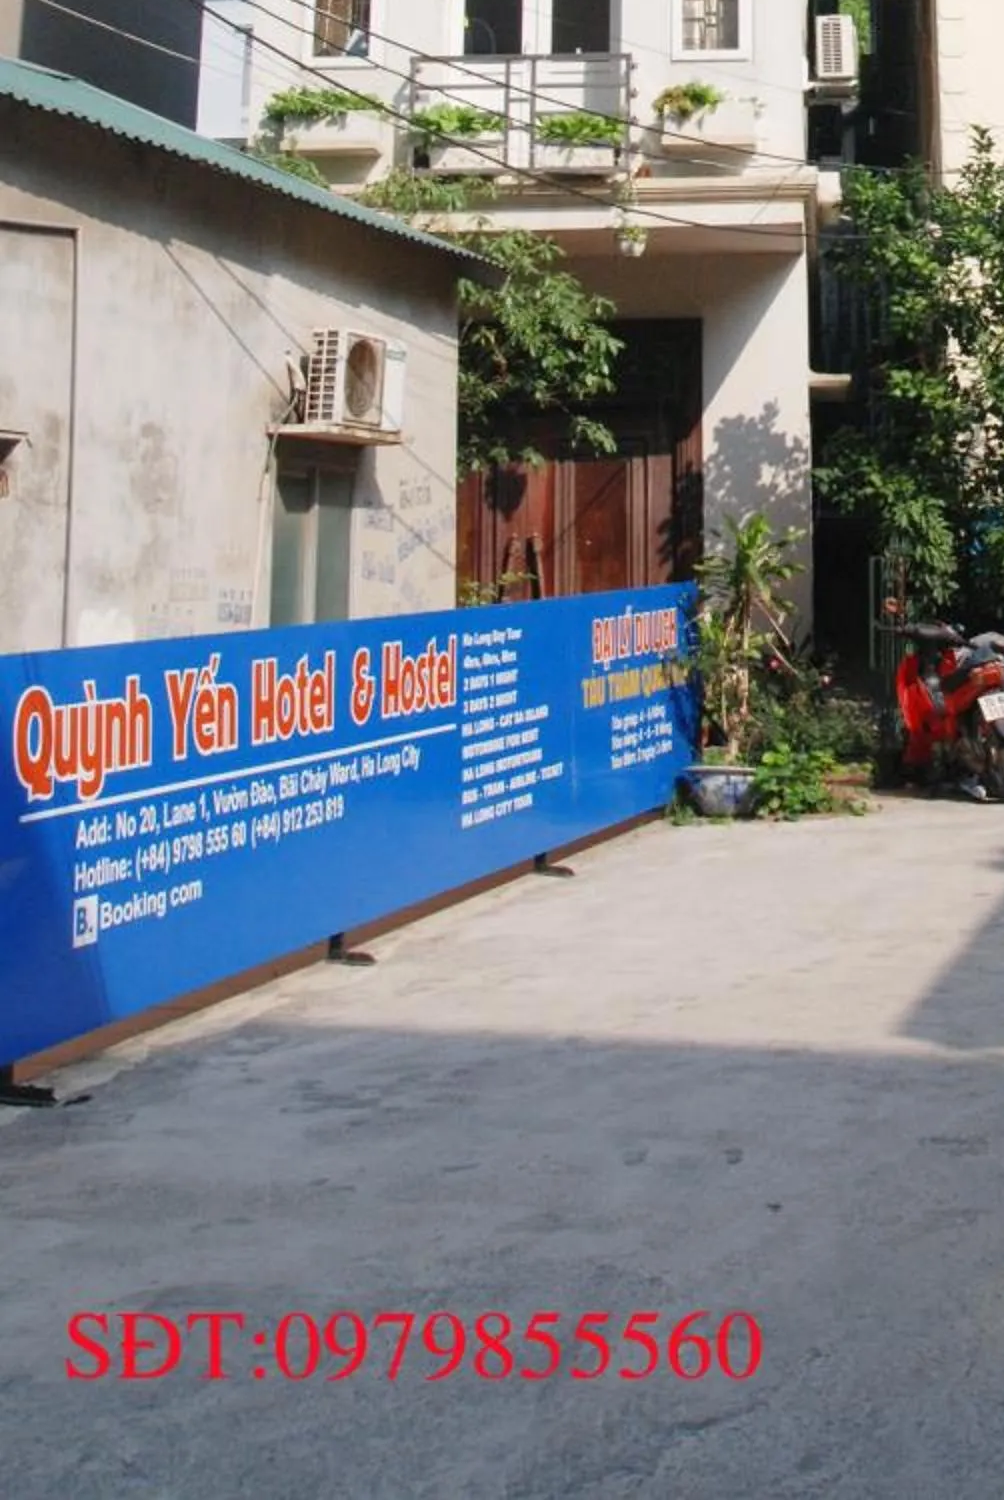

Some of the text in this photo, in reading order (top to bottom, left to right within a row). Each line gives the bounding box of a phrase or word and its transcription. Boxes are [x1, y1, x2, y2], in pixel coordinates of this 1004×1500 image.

[15, 634, 457, 801] Quỳnh Yến Hotel & Hostel
[76, 816, 112, 849] Add:
[115, 810, 136, 840] No
[139, 804, 160, 834] 20,
[163, 801, 196, 828] Lane
[74, 858, 132, 893] Hotline:
[134, 838, 170, 881] (+84)
[205, 823, 228, 855] 555
[100, 890, 167, 929] Booking
